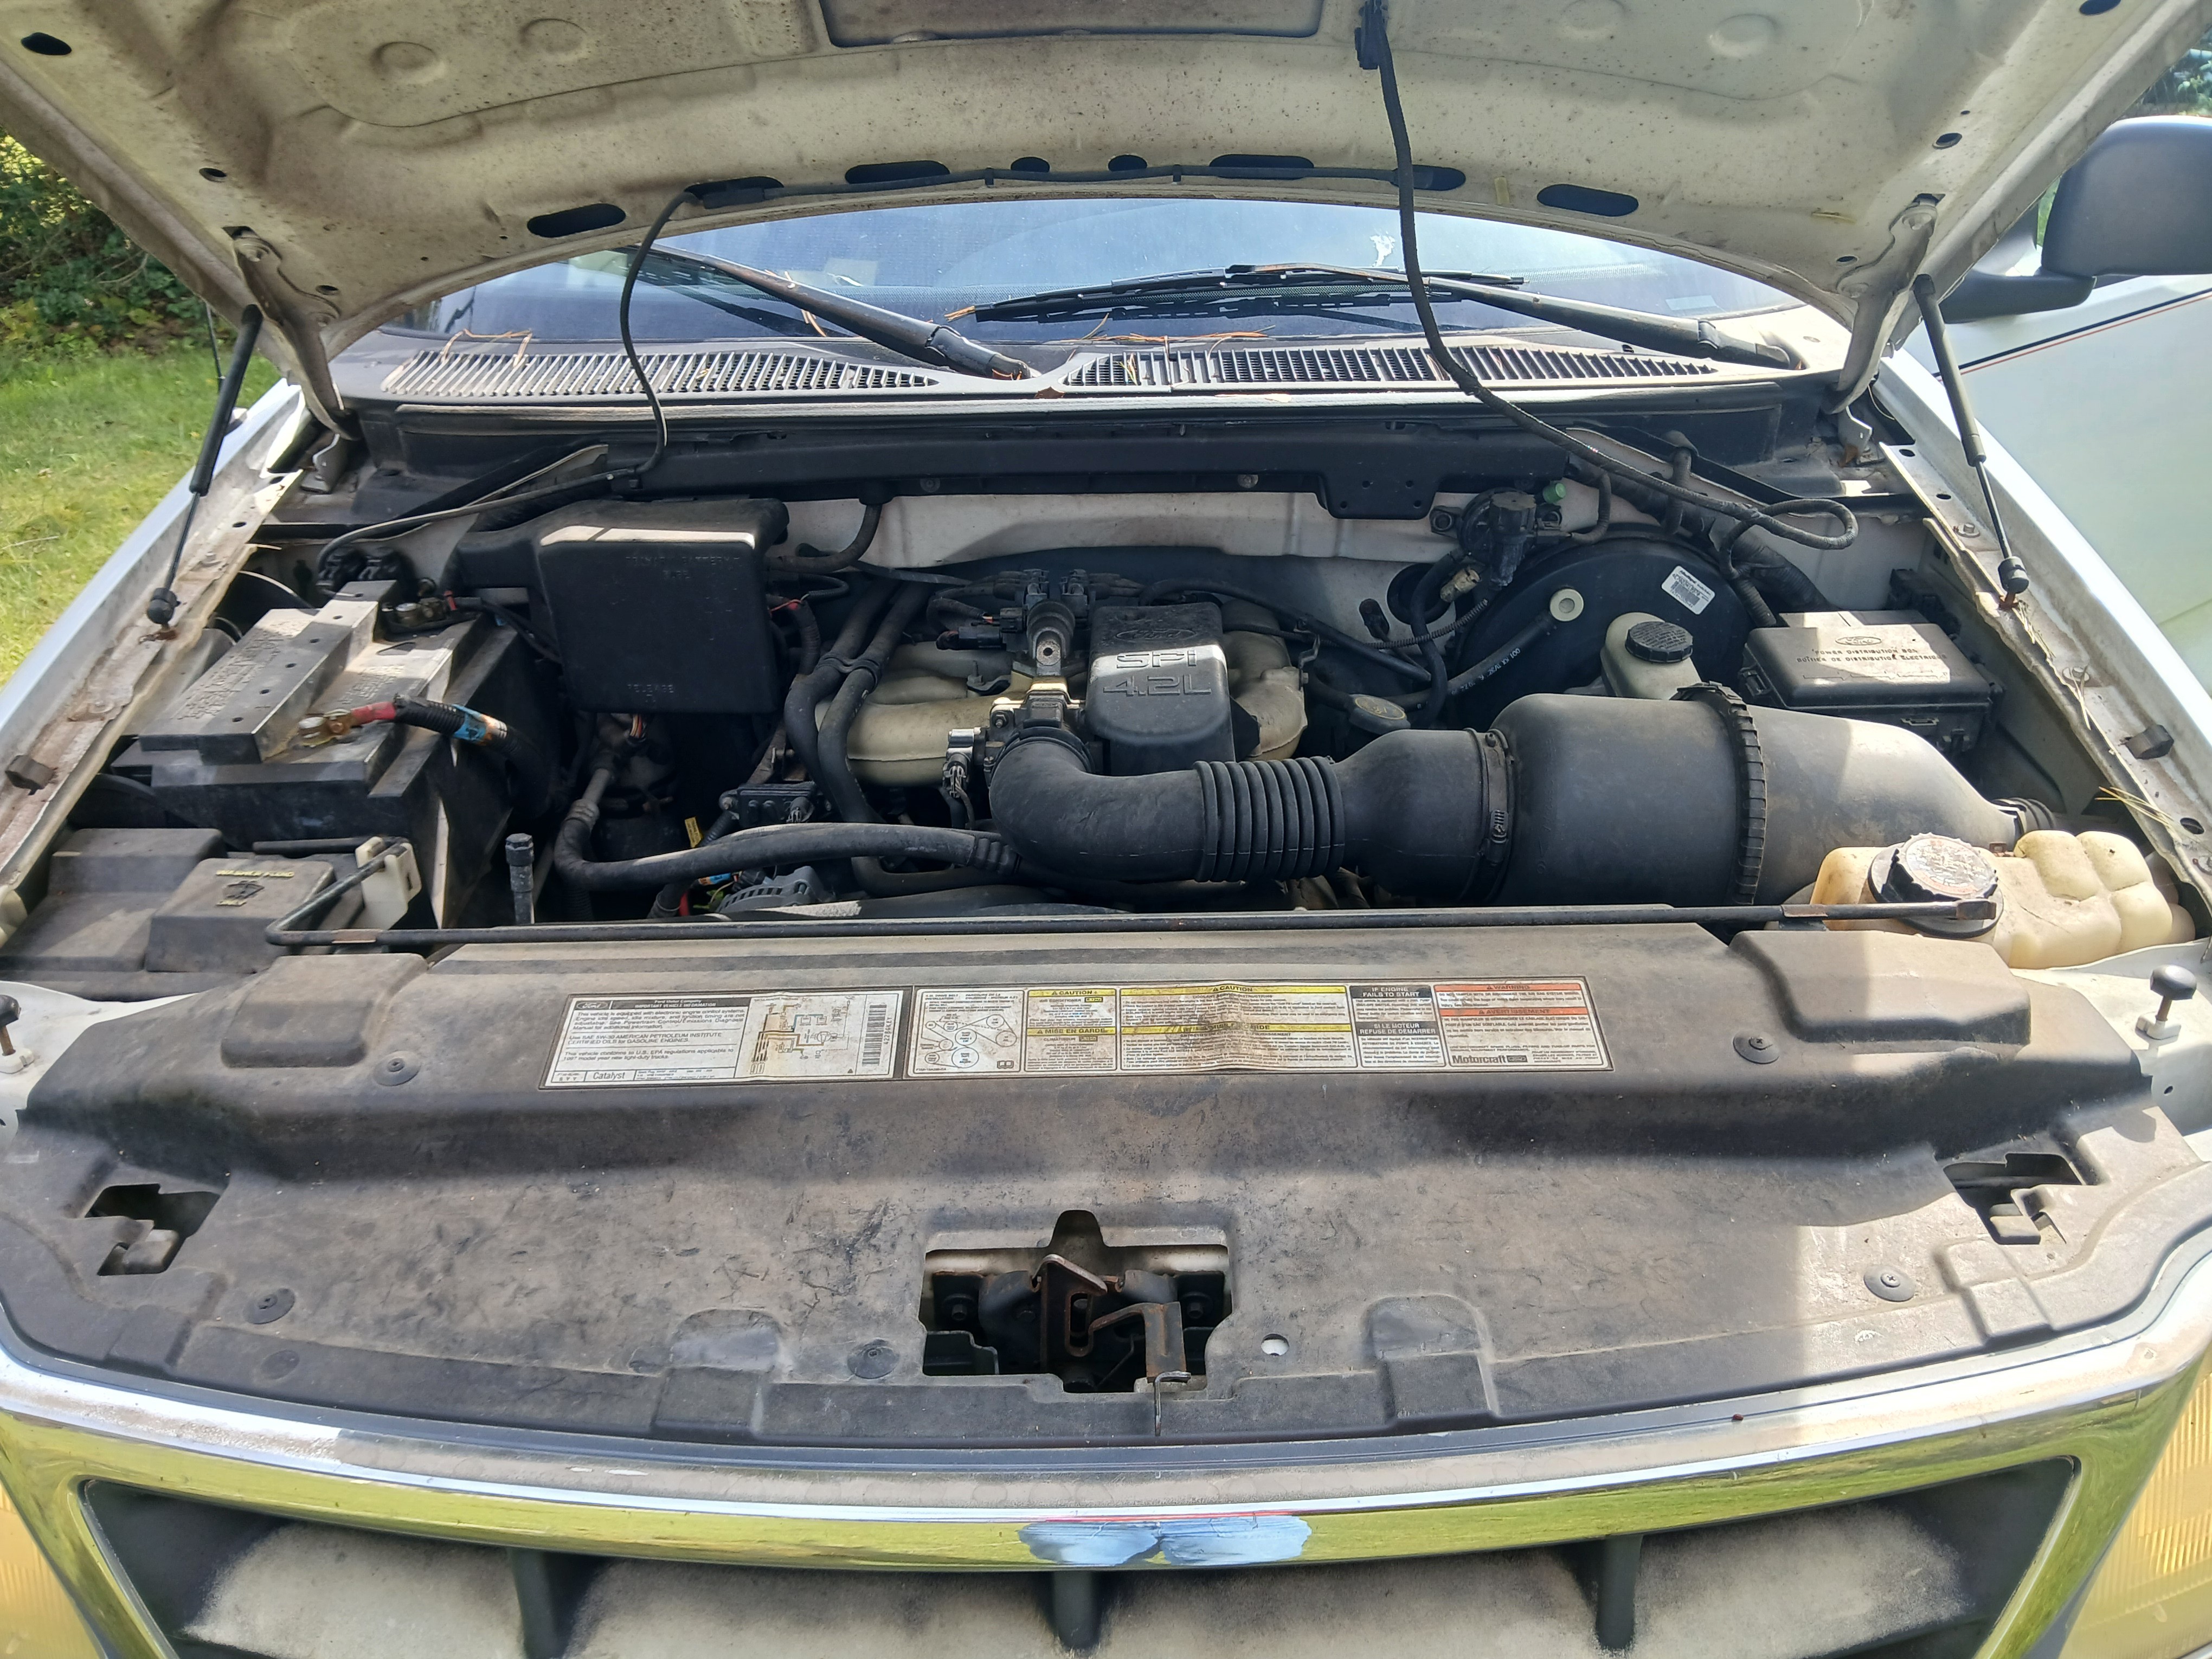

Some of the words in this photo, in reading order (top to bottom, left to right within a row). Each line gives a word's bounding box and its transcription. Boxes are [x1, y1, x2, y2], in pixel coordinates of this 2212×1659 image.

[1117, 650, 1197, 669] SPI
[1103, 674, 1212, 697] 4.2L
[1452, 1055, 1507, 1064] Motorcraft
[593, 1072, 626, 1080] Catalyst
